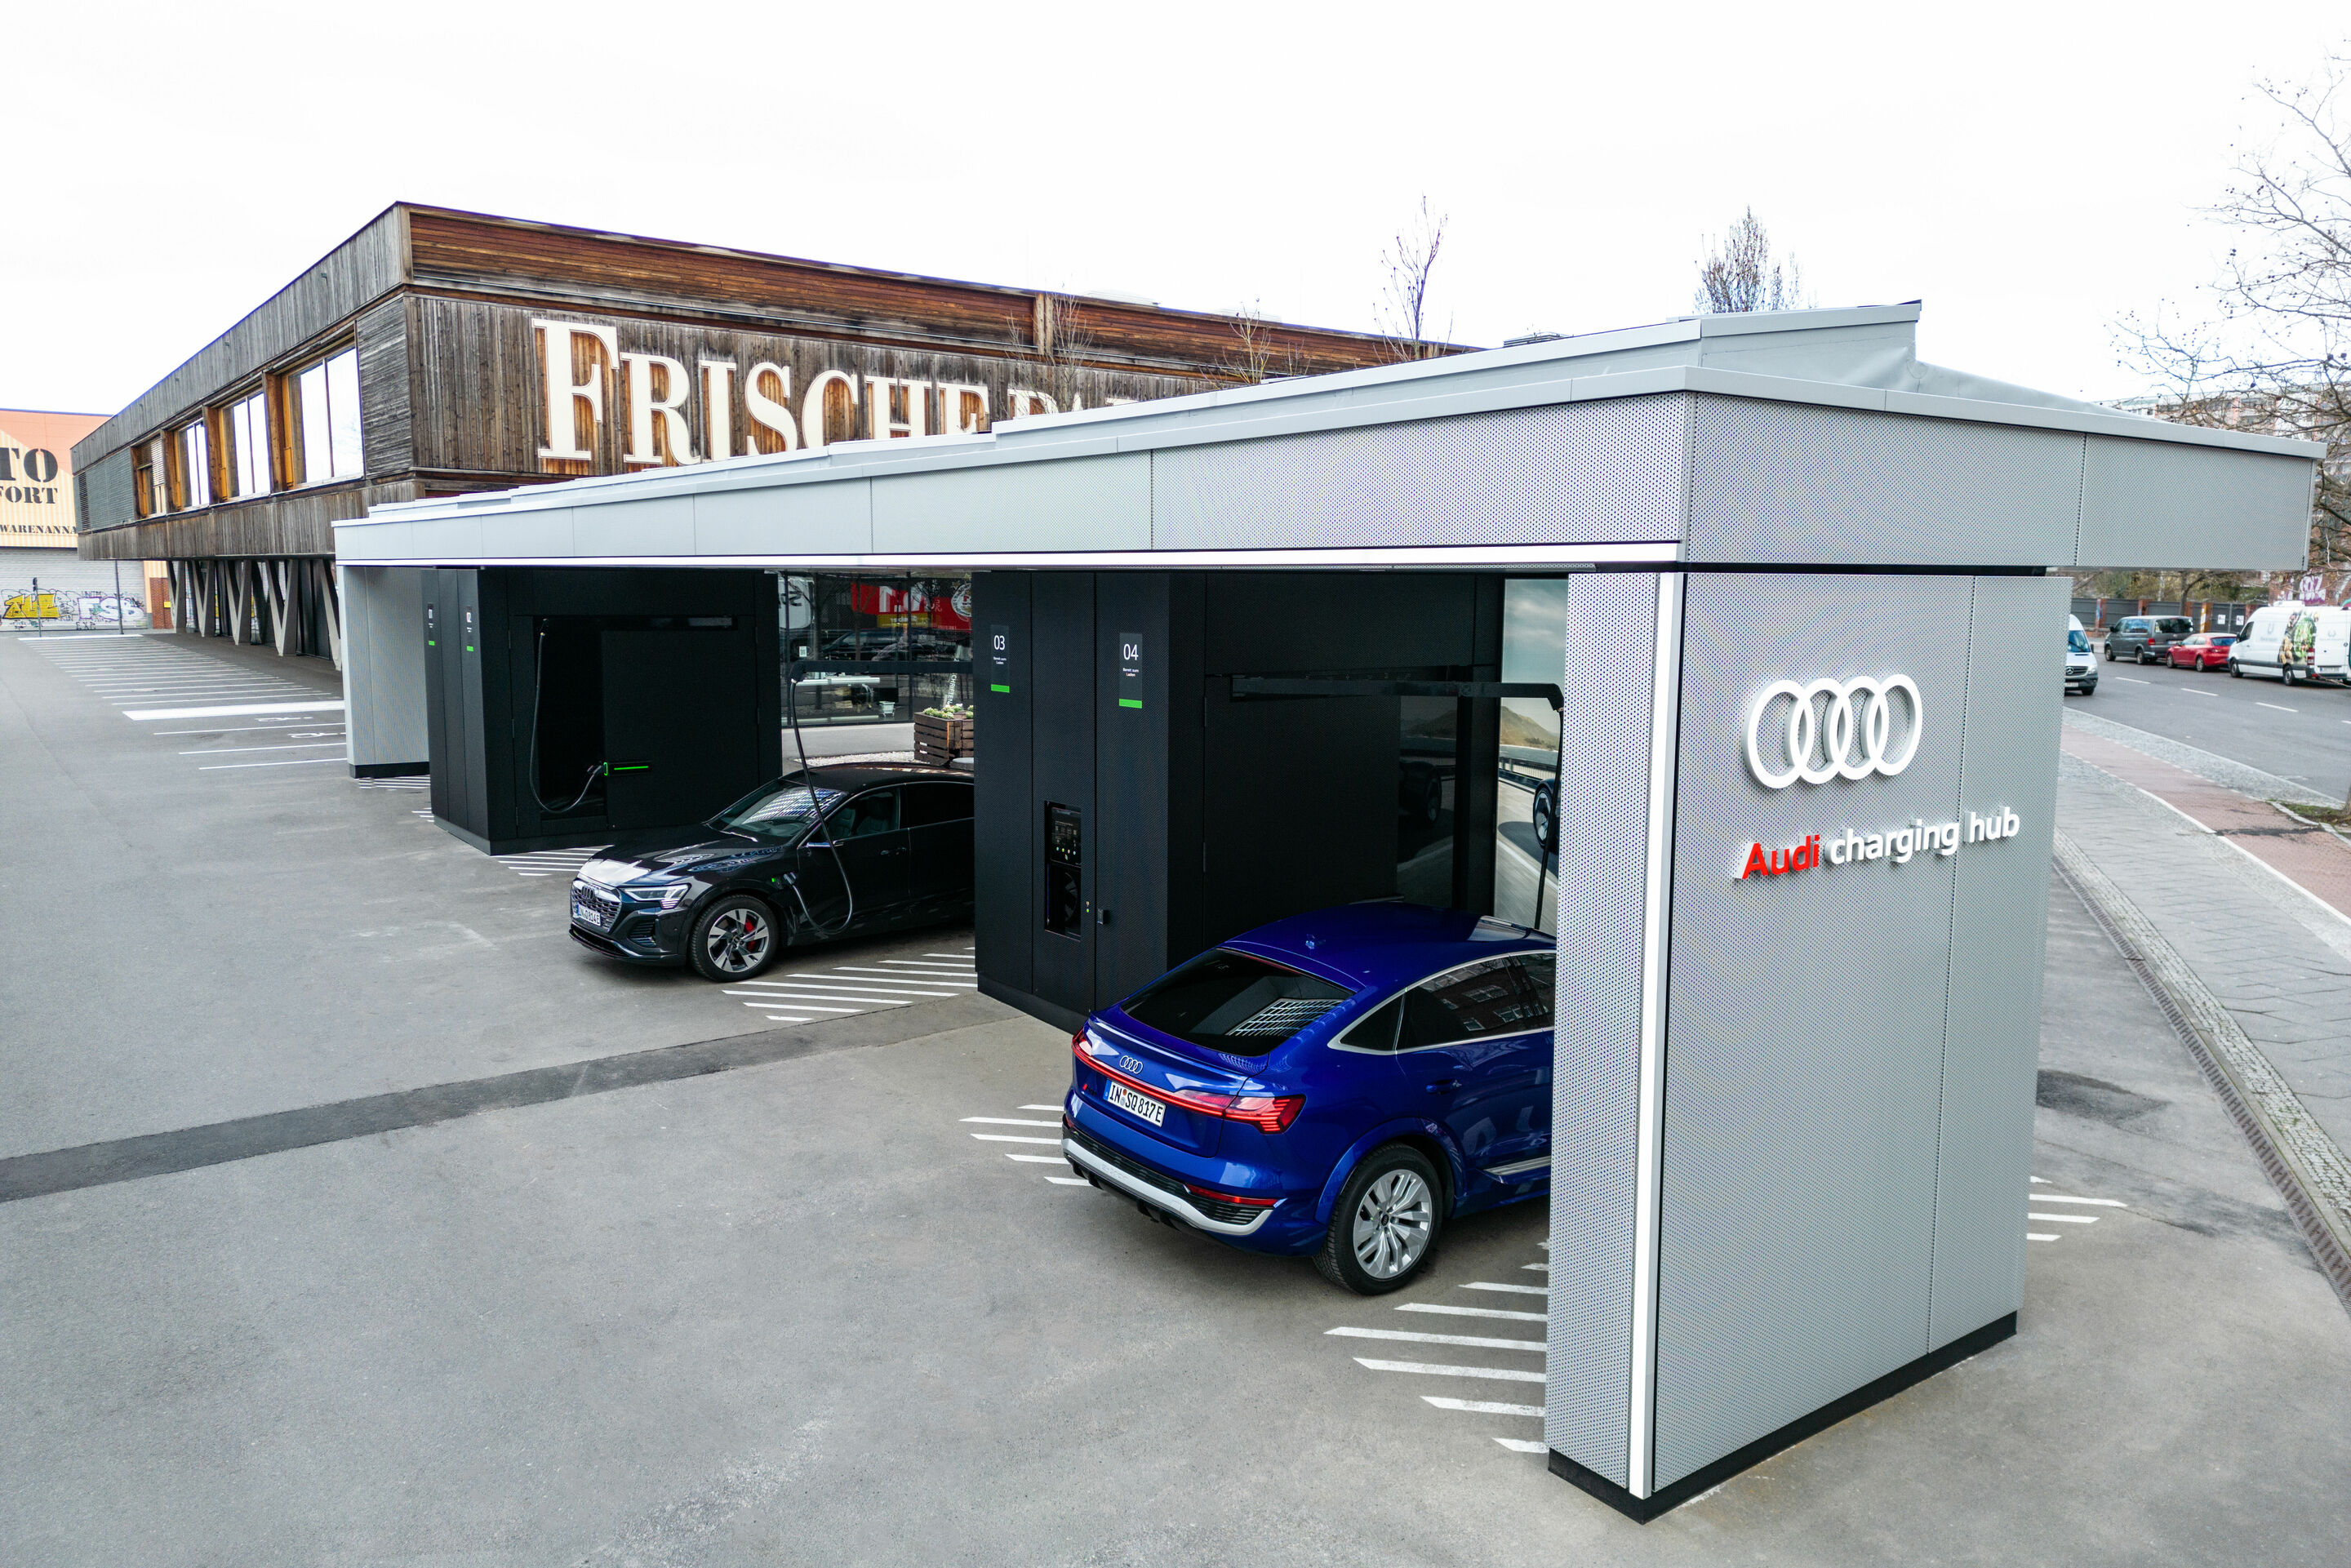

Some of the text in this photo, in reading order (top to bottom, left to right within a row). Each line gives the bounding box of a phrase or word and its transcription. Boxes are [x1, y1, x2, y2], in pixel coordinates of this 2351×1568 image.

[0, 485, 58, 504] ORT
[993, 634, 1006, 651] 03
[1123, 643, 1139, 661] 04
[1738, 806, 2020, 880] Audi charging hub
[1109, 1084, 1122, 1104] IN
[1125, 1092, 1139, 1111] SQ
